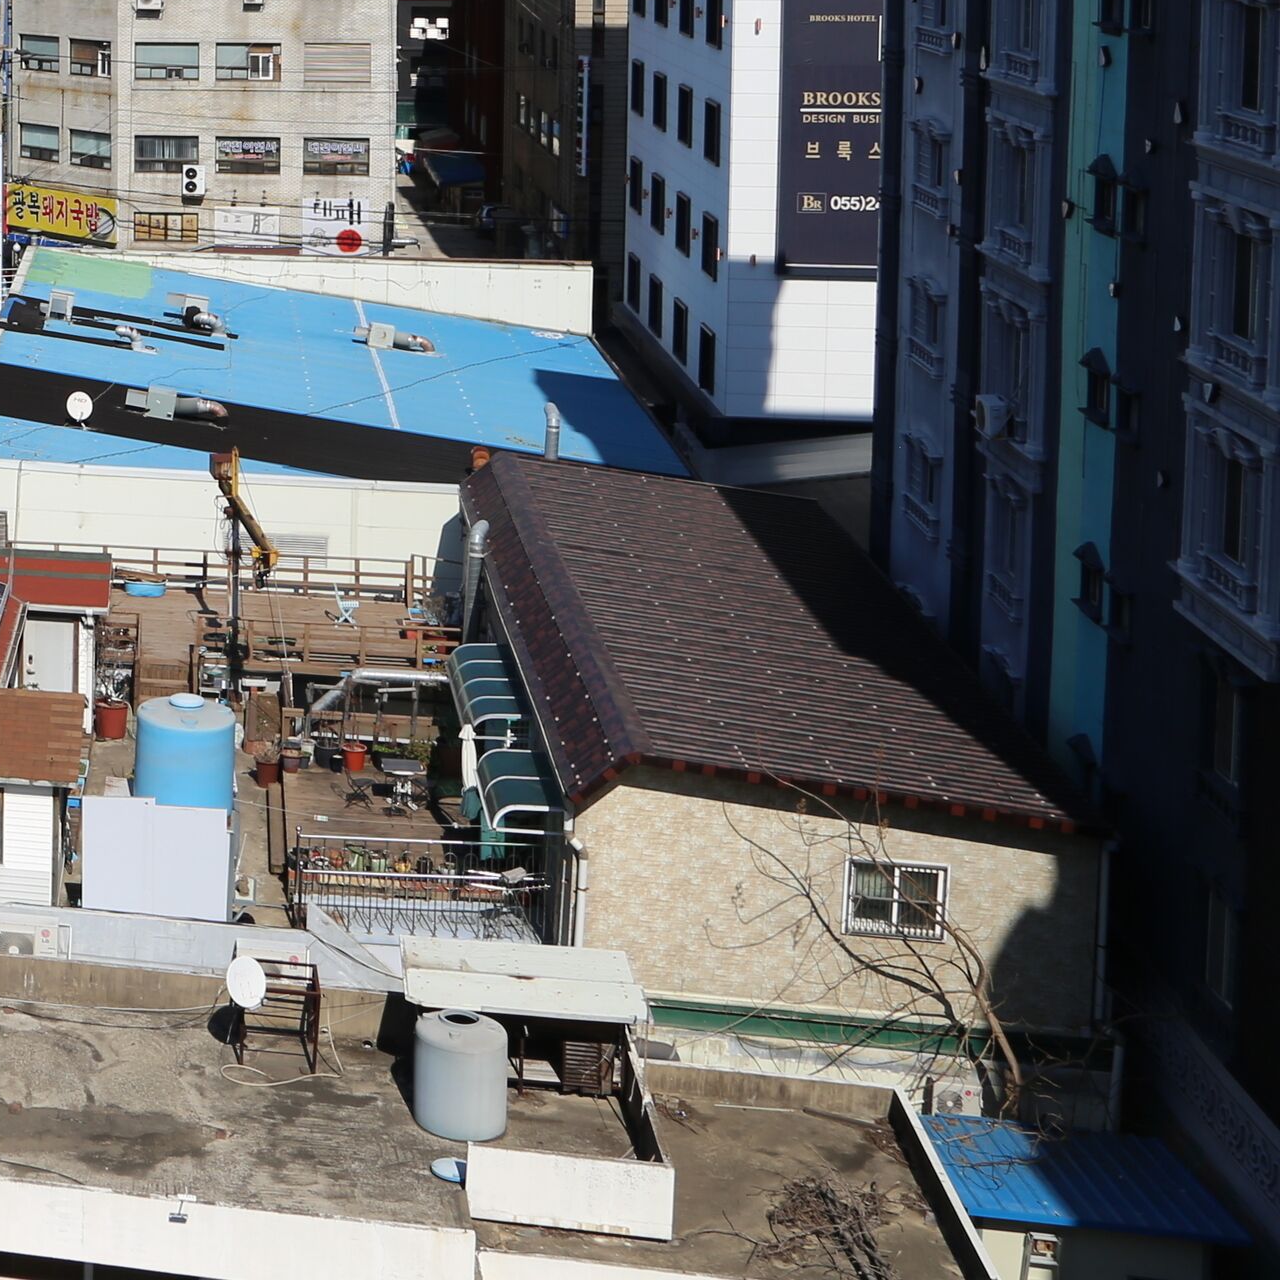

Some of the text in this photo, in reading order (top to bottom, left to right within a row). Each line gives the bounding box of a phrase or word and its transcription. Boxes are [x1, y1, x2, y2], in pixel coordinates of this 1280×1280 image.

[809, 14, 877, 22] BROOKS HOTEL
[803, 92, 881, 106] BROOKS
[803, 114, 880, 124] DESIGN BUSI
